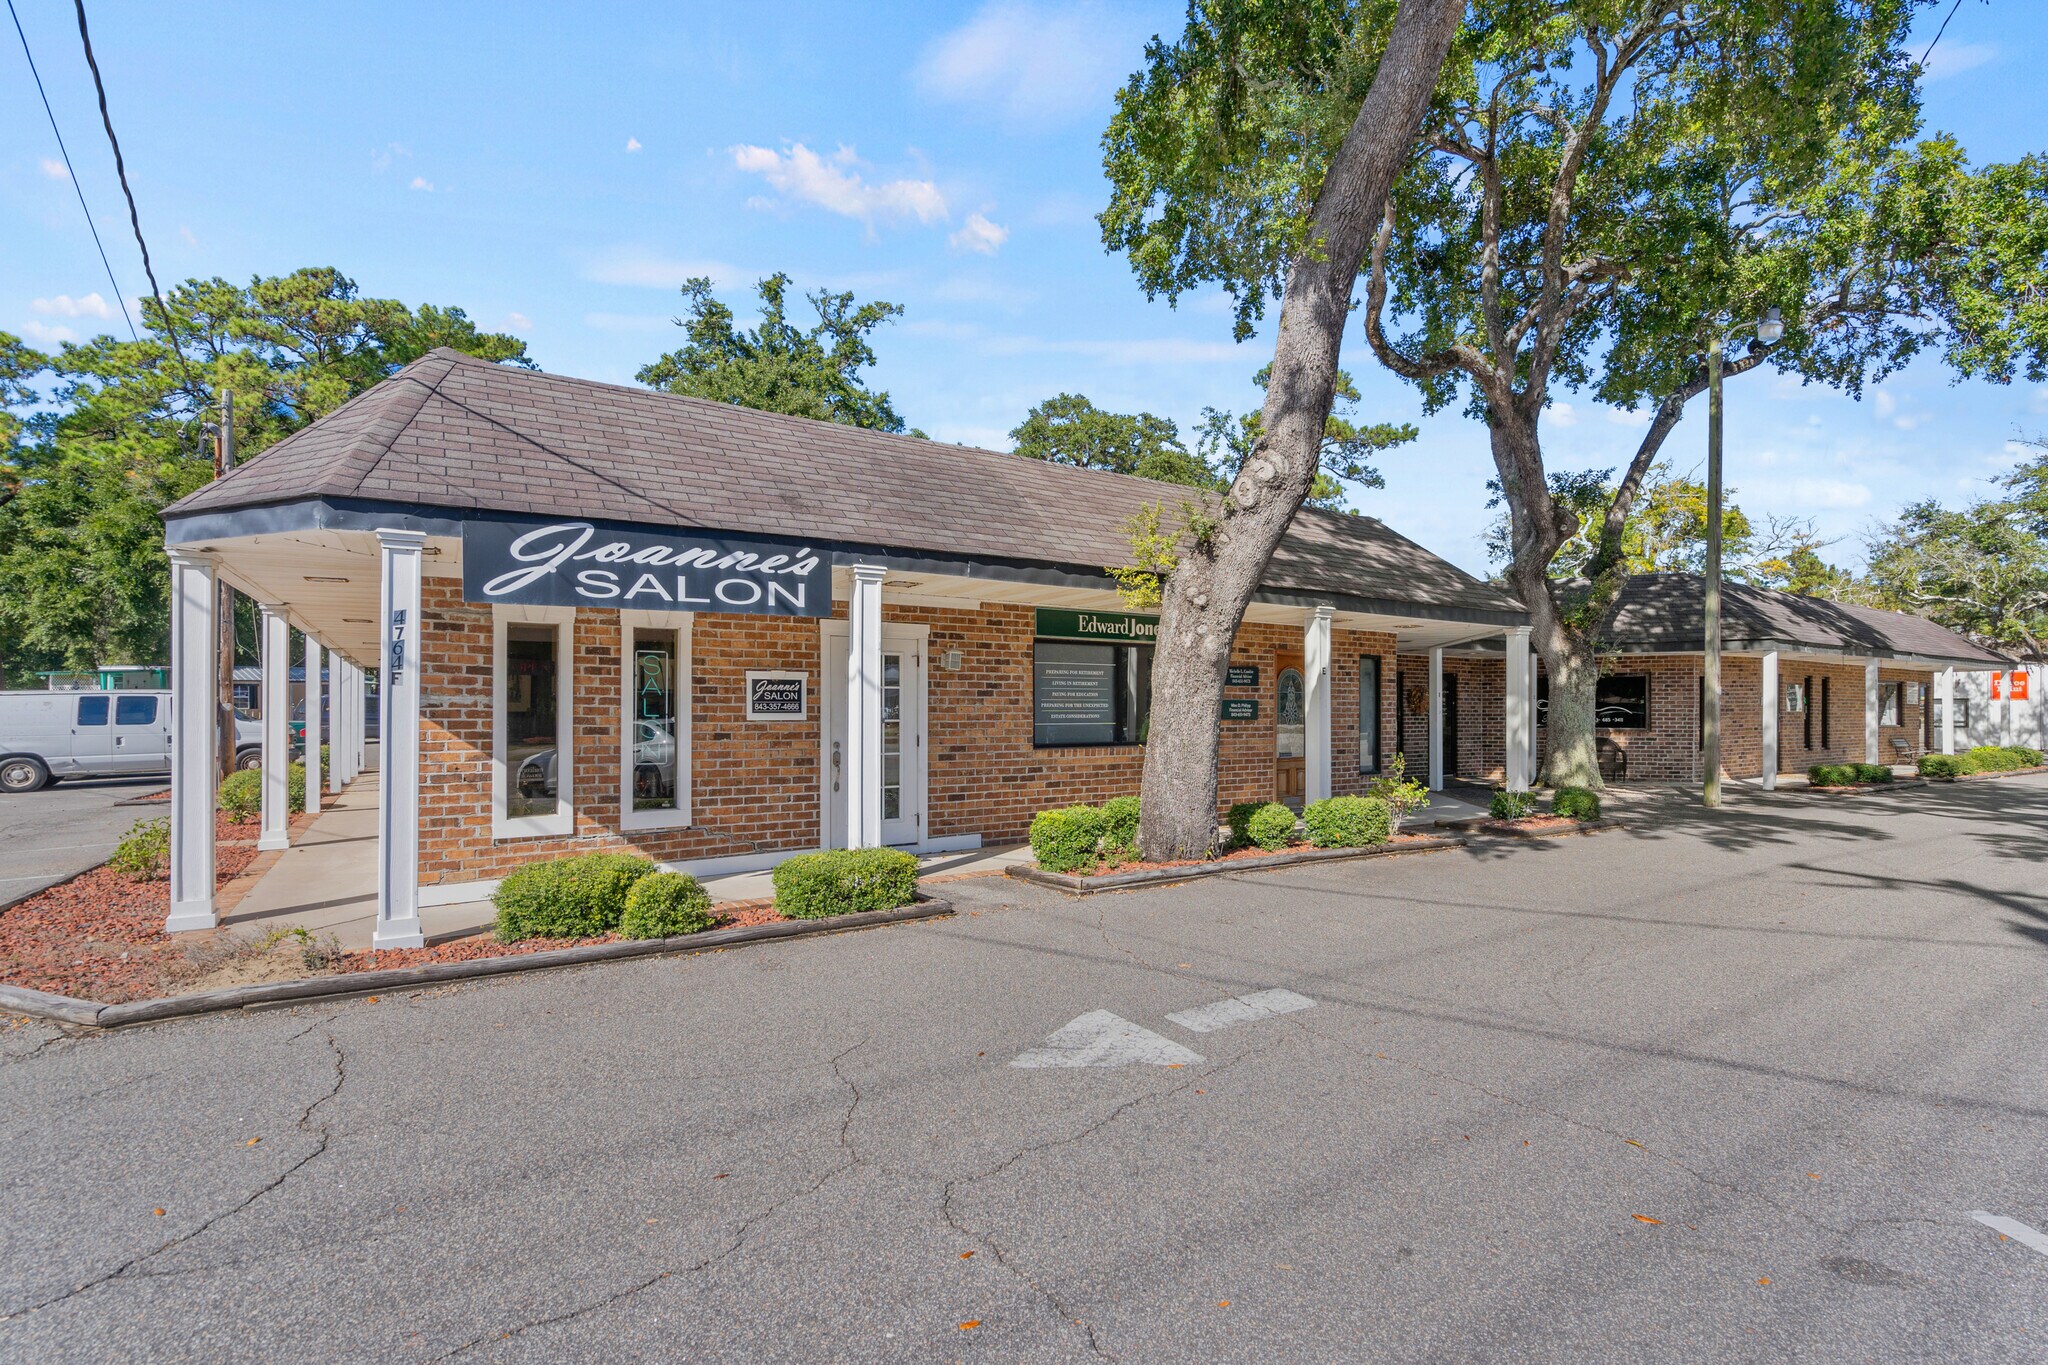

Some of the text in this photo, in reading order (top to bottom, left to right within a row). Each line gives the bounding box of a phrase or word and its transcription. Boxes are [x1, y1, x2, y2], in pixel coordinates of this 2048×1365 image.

[483, 522, 819, 595] Joanne's
[575, 570, 806, 608] SALON
[391, 609, 406, 685] 4764F
[640, 655, 662, 760] SALON
[753, 680, 800, 700] Joanne's
[764, 691, 798, 700] SALON
